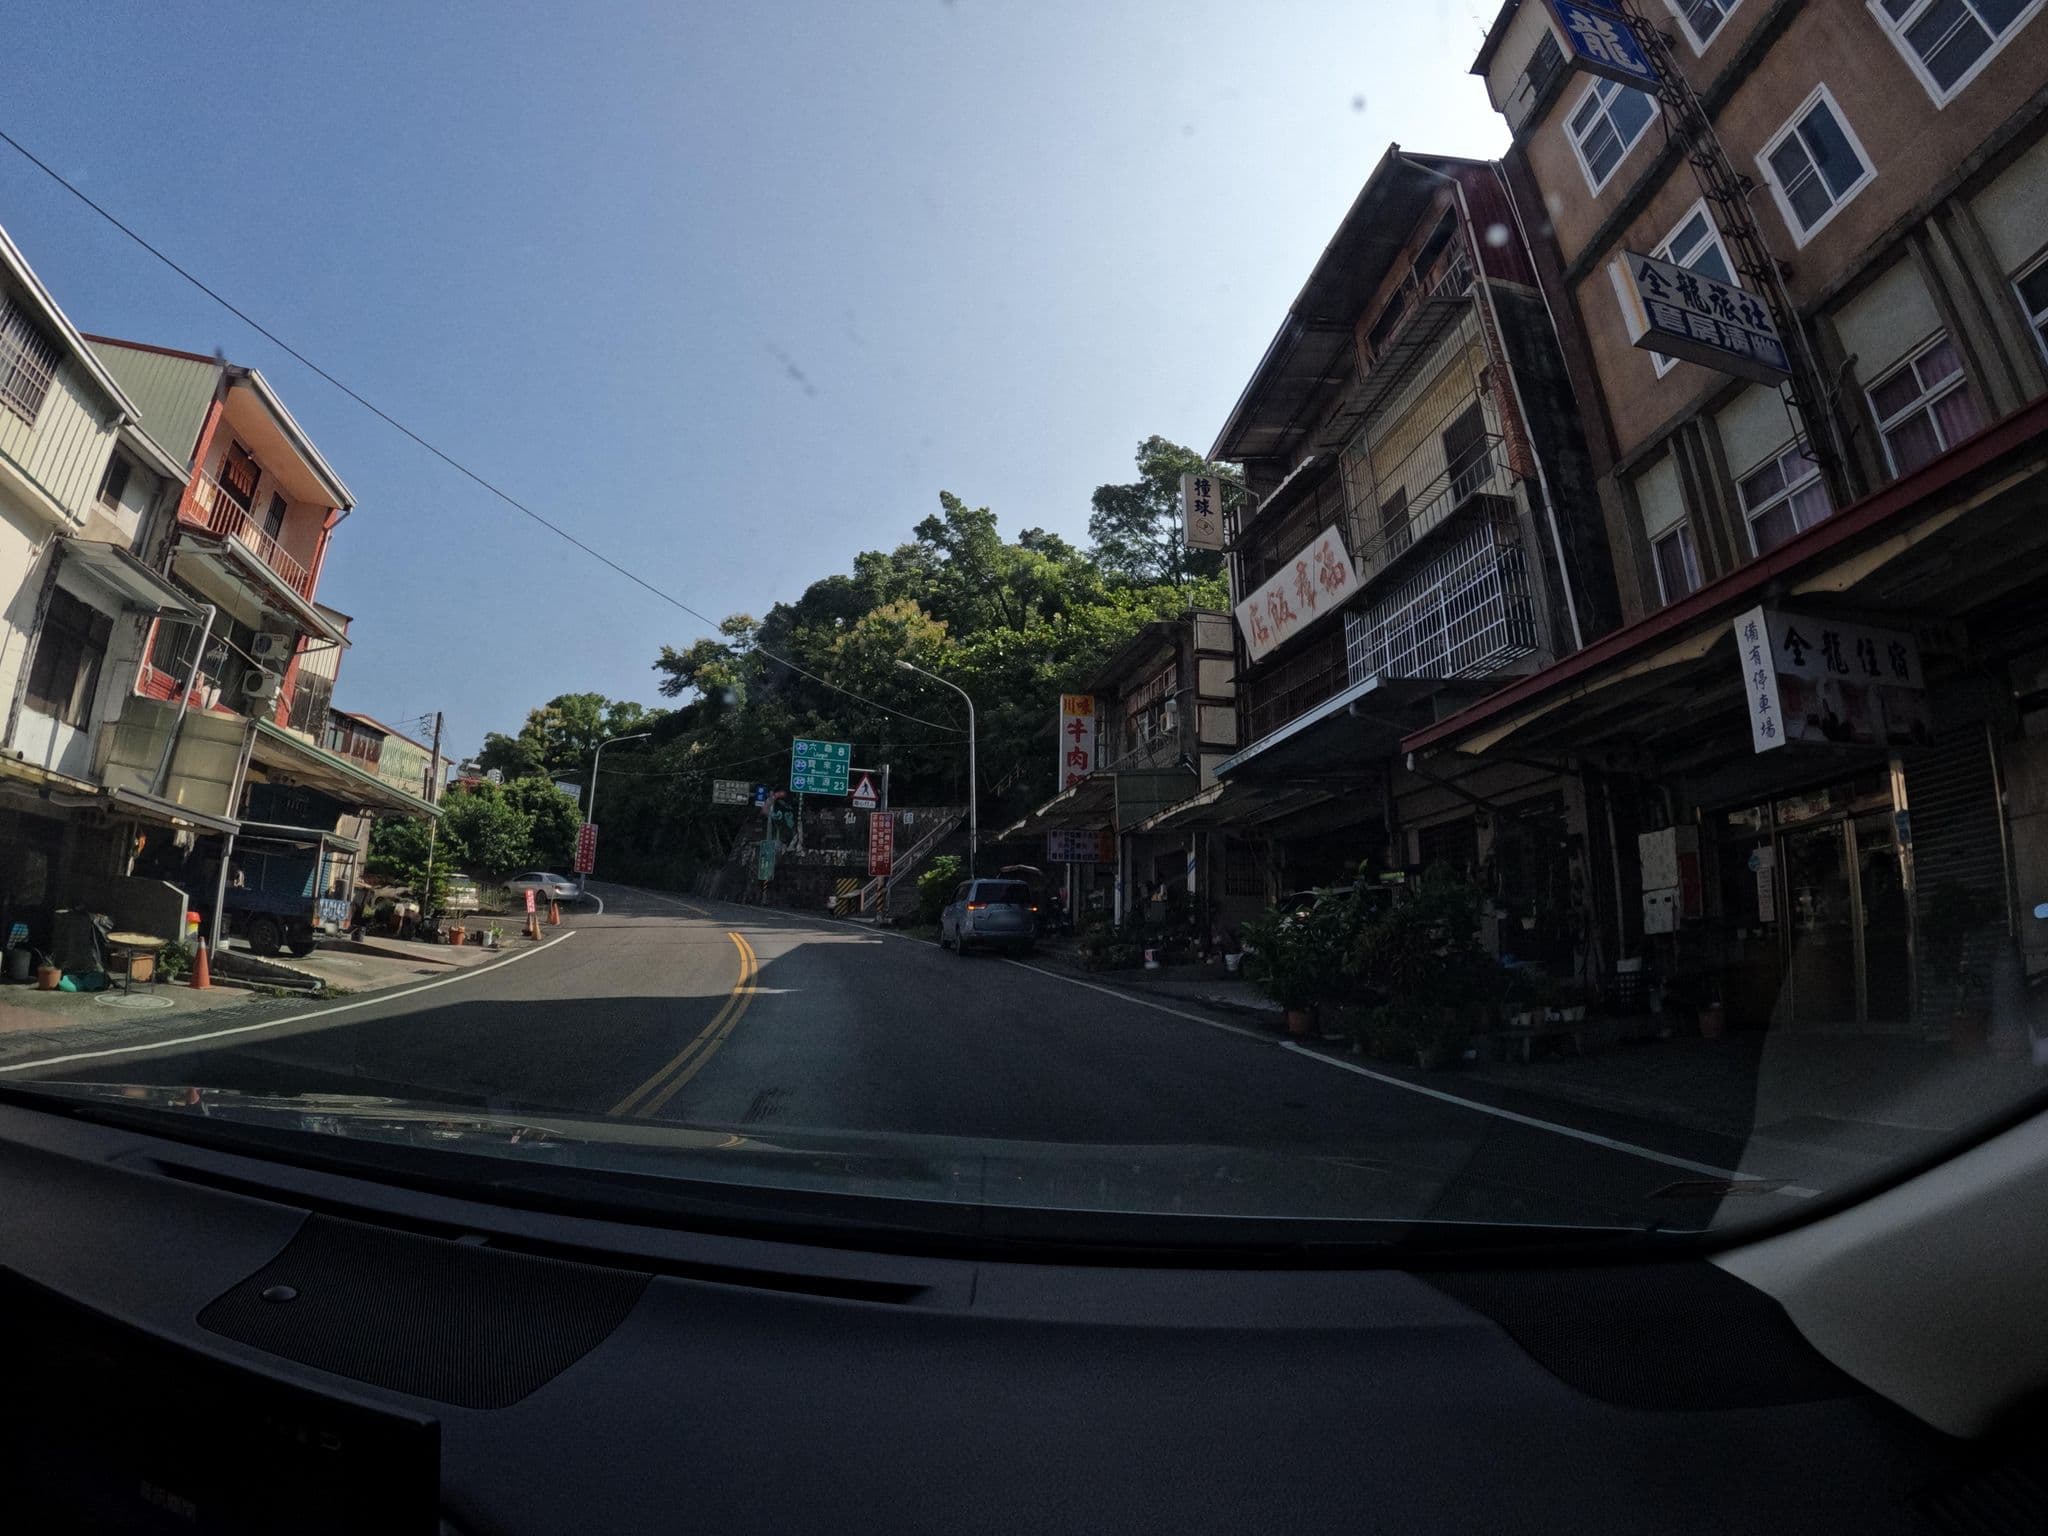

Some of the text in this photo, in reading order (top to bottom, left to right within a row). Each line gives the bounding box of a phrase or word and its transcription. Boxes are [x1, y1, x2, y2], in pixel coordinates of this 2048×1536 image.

[1568, 9, 1647, 73] 龍
[1194, 478, 1214, 517] 撞球
[1744, 620, 1776, 738] 備有停車場
[1064, 698, 1091, 714] 川味
[838, 747, 845, 756] 8
[835, 764, 846, 774] 21
[833, 781, 845, 791] 23
